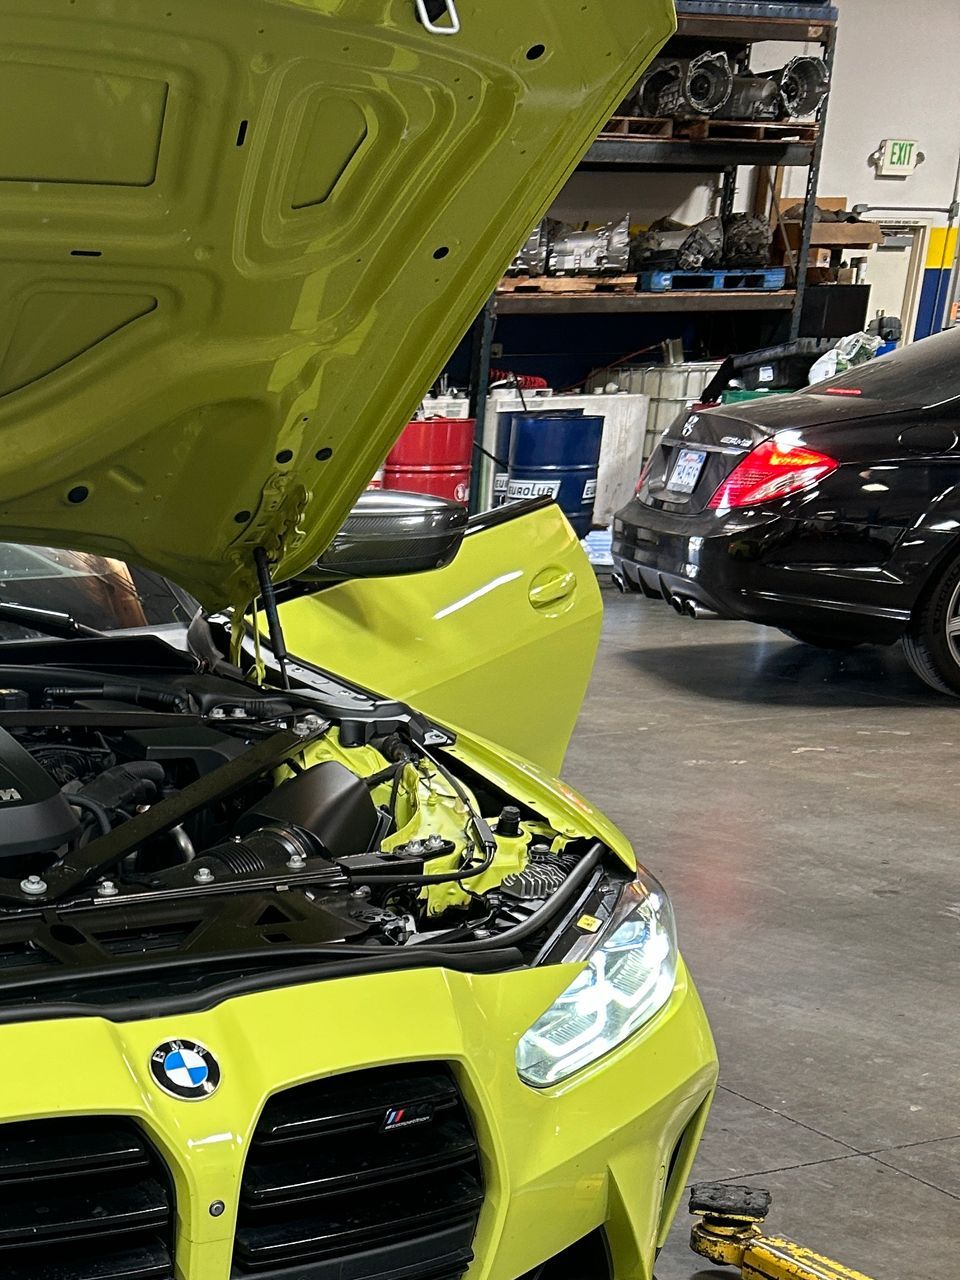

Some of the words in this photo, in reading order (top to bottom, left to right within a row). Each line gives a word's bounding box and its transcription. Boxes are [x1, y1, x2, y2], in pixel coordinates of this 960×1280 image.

[890, 142, 914, 165] EXIT
[508, 483, 555, 498] EUROLUB
[152, 1040, 208, 1063] BMW
